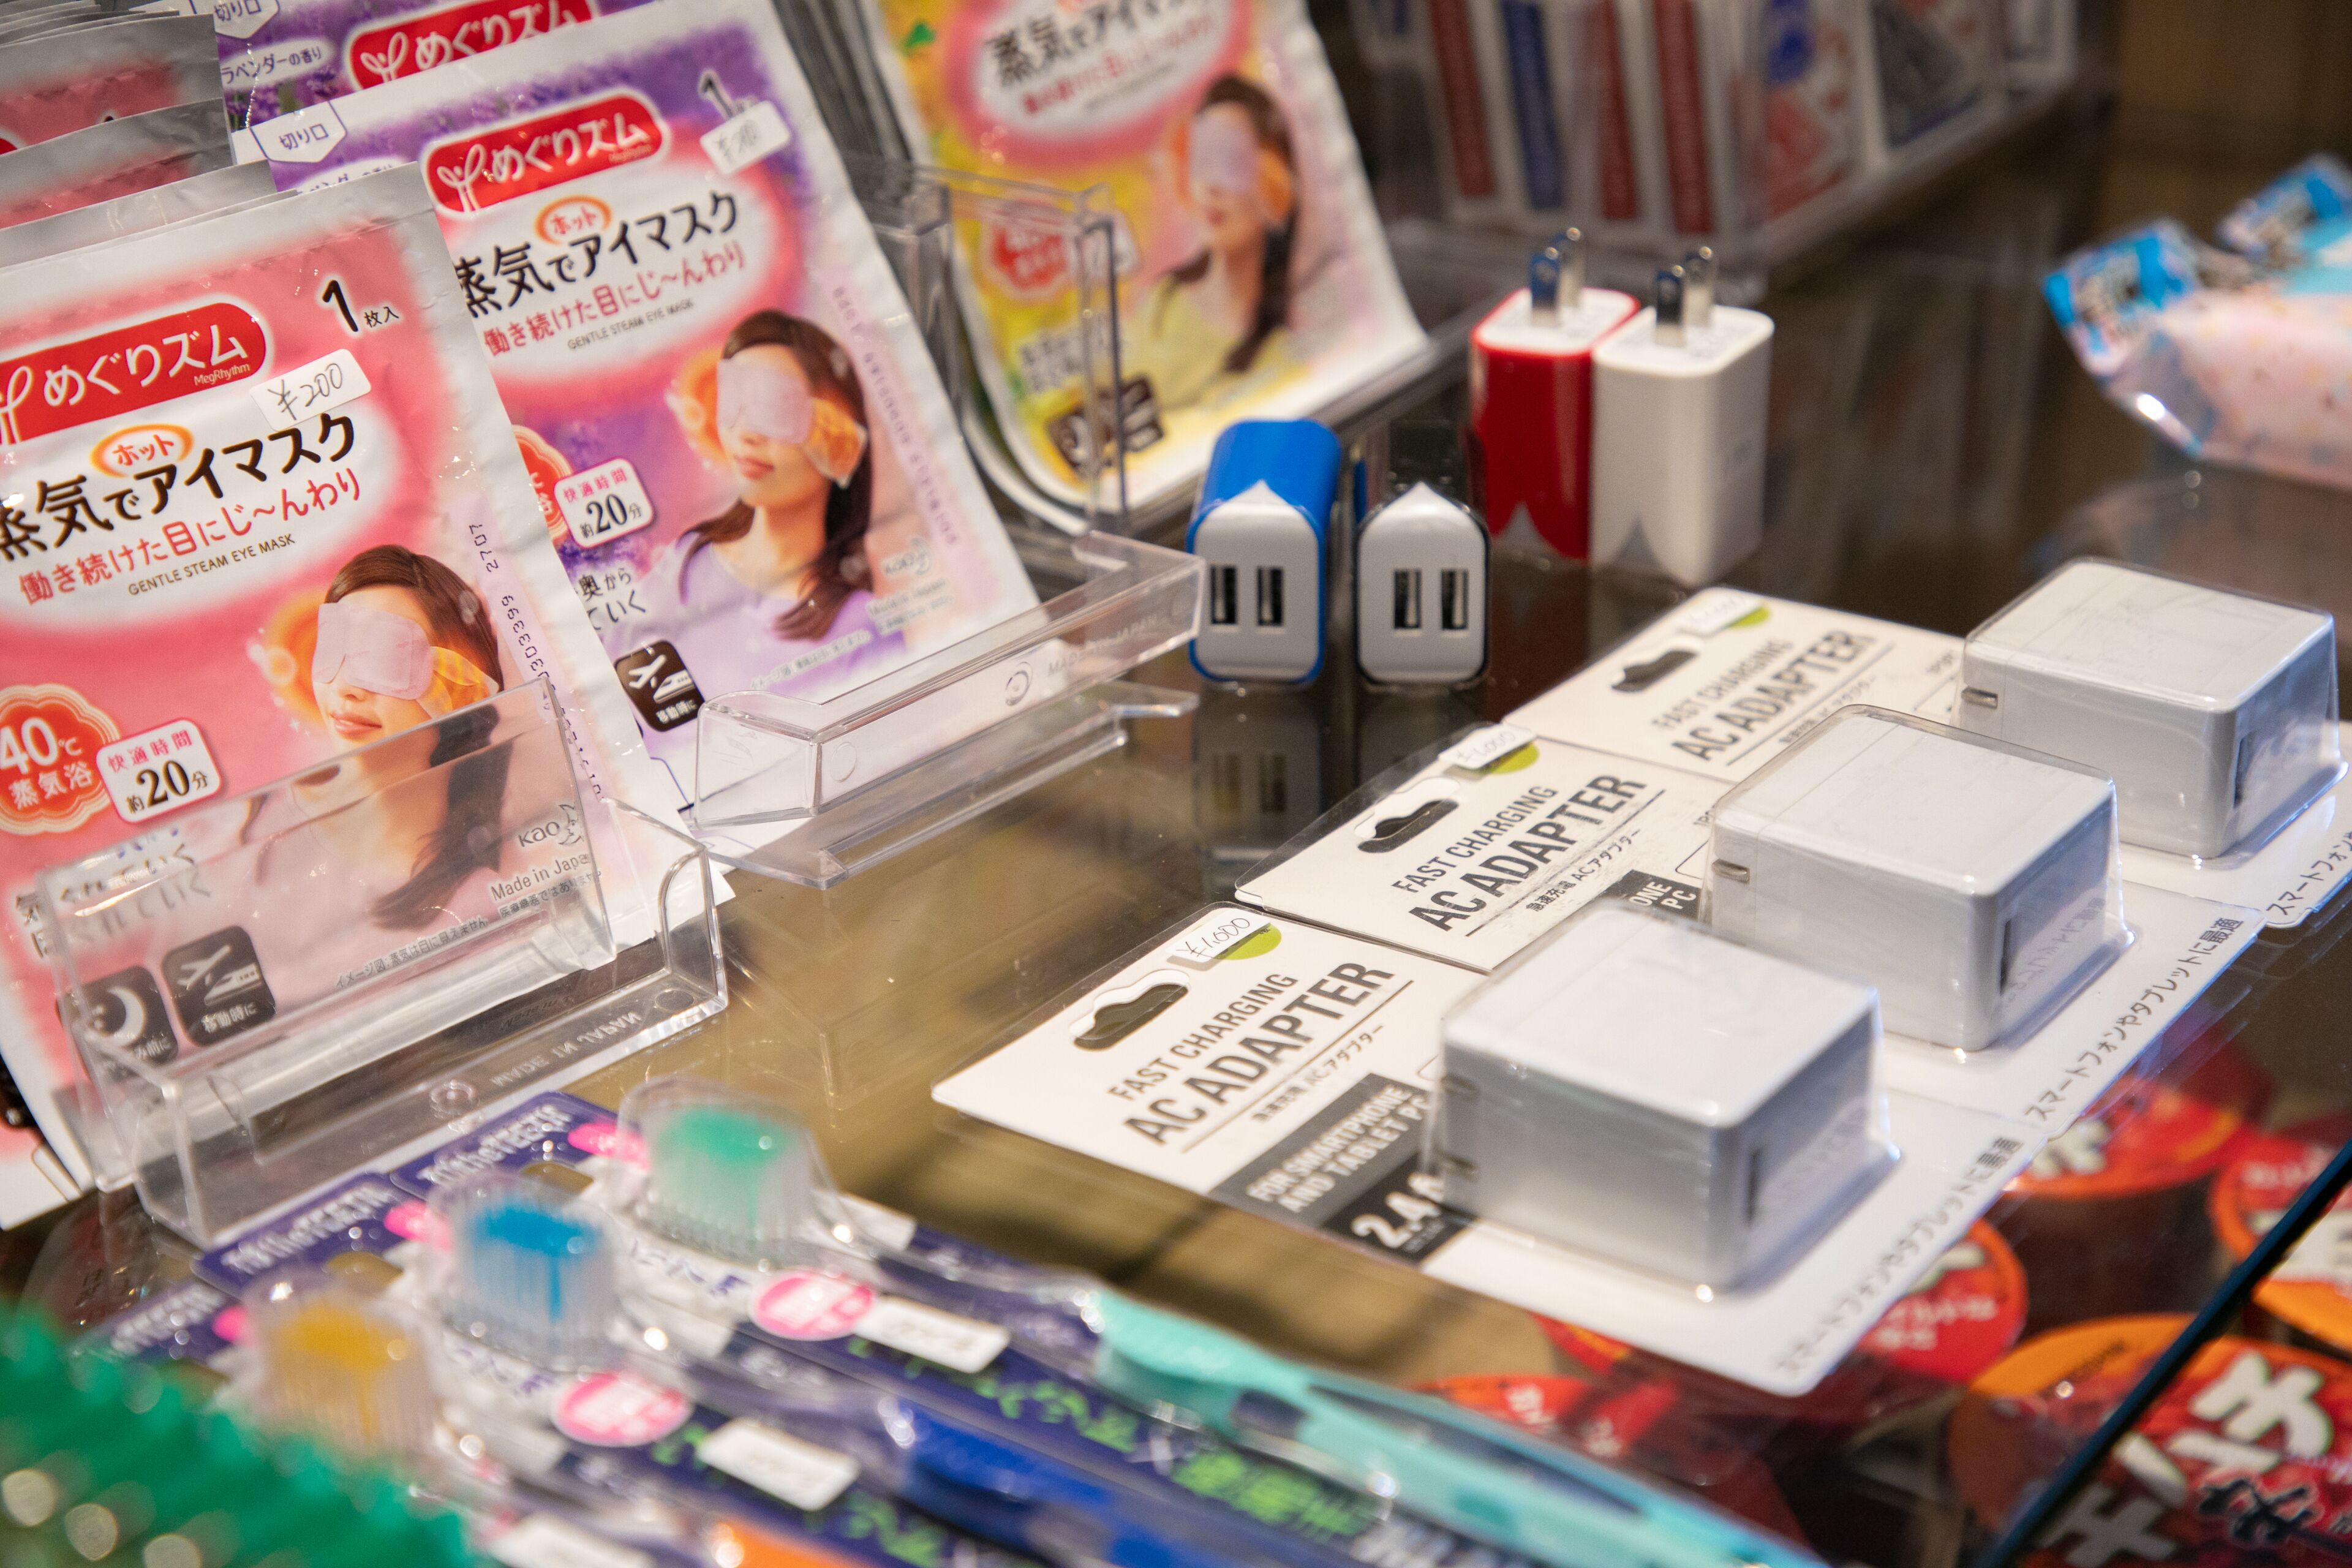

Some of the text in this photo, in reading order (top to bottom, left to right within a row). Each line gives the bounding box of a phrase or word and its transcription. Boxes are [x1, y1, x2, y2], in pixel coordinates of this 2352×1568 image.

[279, 123, 329, 150] 切り口
[492, 112, 650, 183] めぐりズム
[551, 206, 597, 236] ホット
[567, 326, 608, 350] GENTLE
[612, 313, 644, 335] STEAM
[647, 309, 665, 323] EYE
[44, 325, 248, 407] めぐりズム
[194, 363, 251, 386] MegRhythm
[268, 363, 342, 421] ¥200
[111, 434, 174, 466] ホット
[563, 468, 628, 504] 快適時間
[579, 493, 643, 540] 約20分
[127, 533, 296, 595] GENTLE STEAM EYE MASK
[575, 568, 631, 601] 奥から
[1652, 697, 1700, 730] FAST
[1670, 725, 1740, 761] AC
[1716, 628, 1879, 733] ADAPTER
[108, 729, 193, 773] 快適時間
[8, 760, 92, 811] 蒸気浴
[126, 760, 208, 814] 約20分
[1391, 785, 1559, 894] FAST CHARGING
[1408, 774, 1648, 932] AC ADAPTER
[490, 876, 532, 901] Made
[532, 868, 550, 883] in
[1525, 879, 1577, 913] 急速充電
[1628, 880, 1673, 909] ONE
[1661, 888, 1698, 910] PC
[201, 1001, 257, 1034] 移動時に
[1106, 973, 1299, 1101] FAST CHARGING
[2024, 917, 2244, 1121] スマートフォンやタブレットに最適
[1123, 962, 1396, 1145] AC ADAPTER
[1246, 1085, 1413, 1202] FOR SMARTPHONE
[1276, 1171, 1336, 1213] AND
[1323, 1115, 1410, 1177] TABLET
